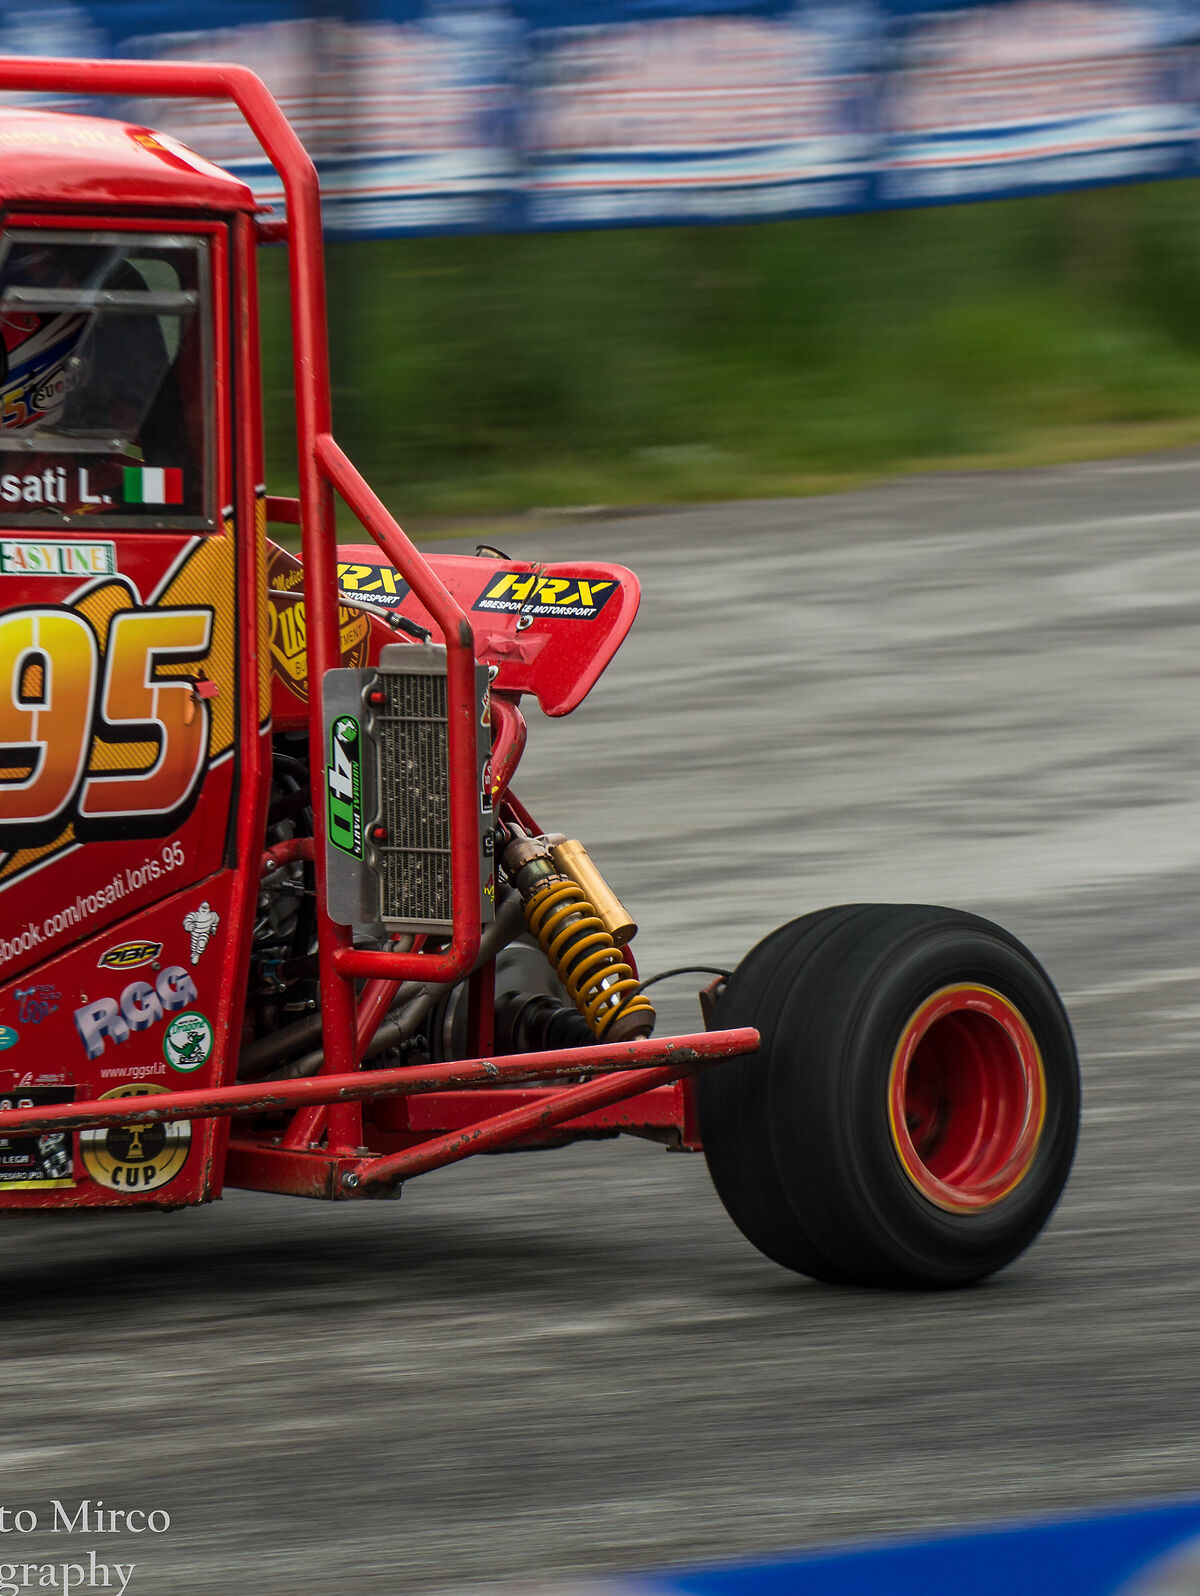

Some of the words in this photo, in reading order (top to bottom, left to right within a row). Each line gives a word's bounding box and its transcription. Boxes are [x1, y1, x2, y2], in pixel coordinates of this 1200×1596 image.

[79, 467, 112, 504] L.
[338, 563, 403, 595] RX
[486, 574, 614, 606] HRX
[345, 592, 400, 605] OTORSPORT
[532, 604, 598, 617] MOTORSPORT
[74, 965, 198, 1061] RGG
[101, 1062, 167, 1080] www.rggsrl.it
[2, 1155, 30, 1164] LEGA
[111, 1164, 157, 1187] CUP
